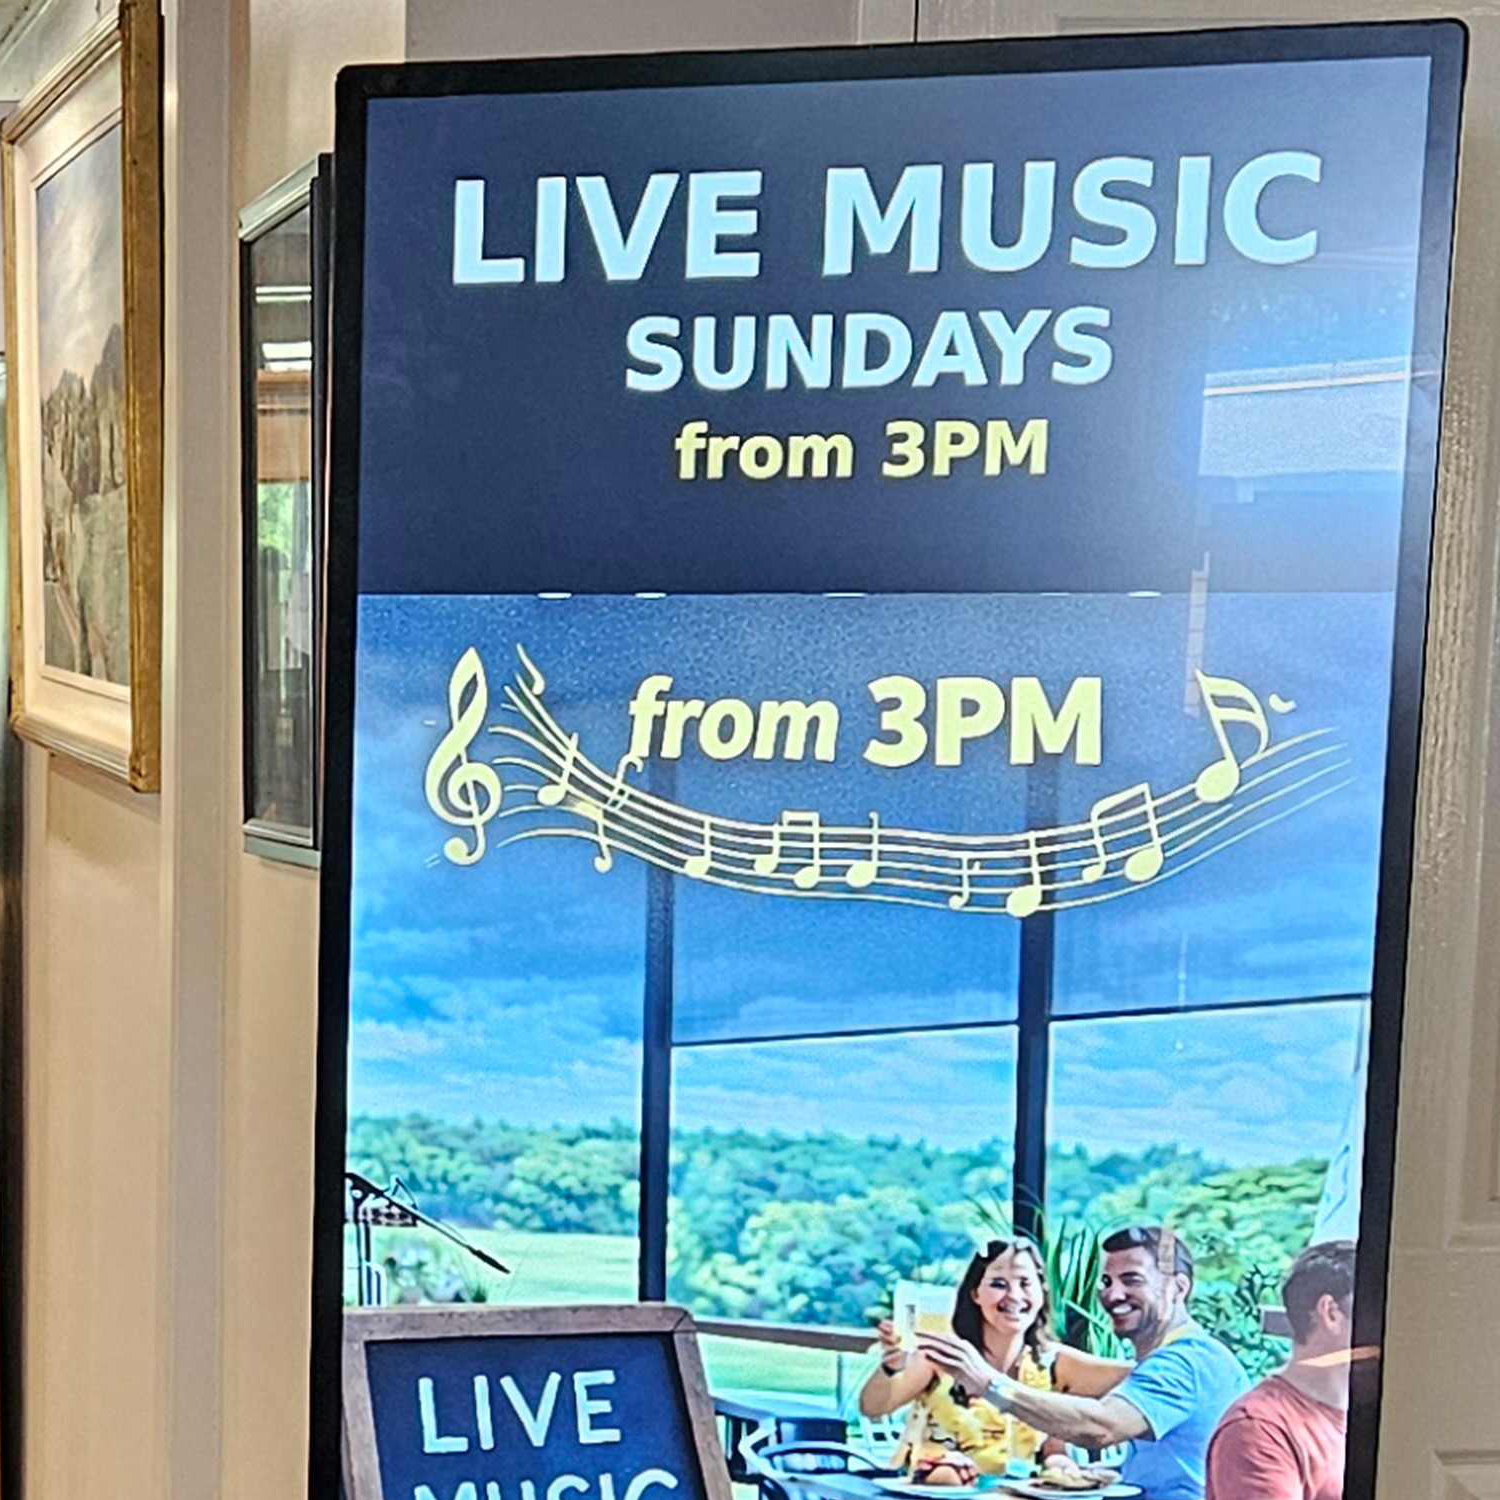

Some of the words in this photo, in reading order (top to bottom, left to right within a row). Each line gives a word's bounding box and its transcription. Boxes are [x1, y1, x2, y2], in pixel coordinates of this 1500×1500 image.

[451, 170, 763, 286] LIVE
[822, 150, 1322, 276] MUSIC
[625, 305, 1113, 393] SUNDAYS
[674, 420, 854, 480] from
[881, 417, 1050, 479] 3PM
[630, 674, 840, 762] from
[862, 675, 1103, 767] 3PM
[417, 1368, 622, 1455] LIVE
